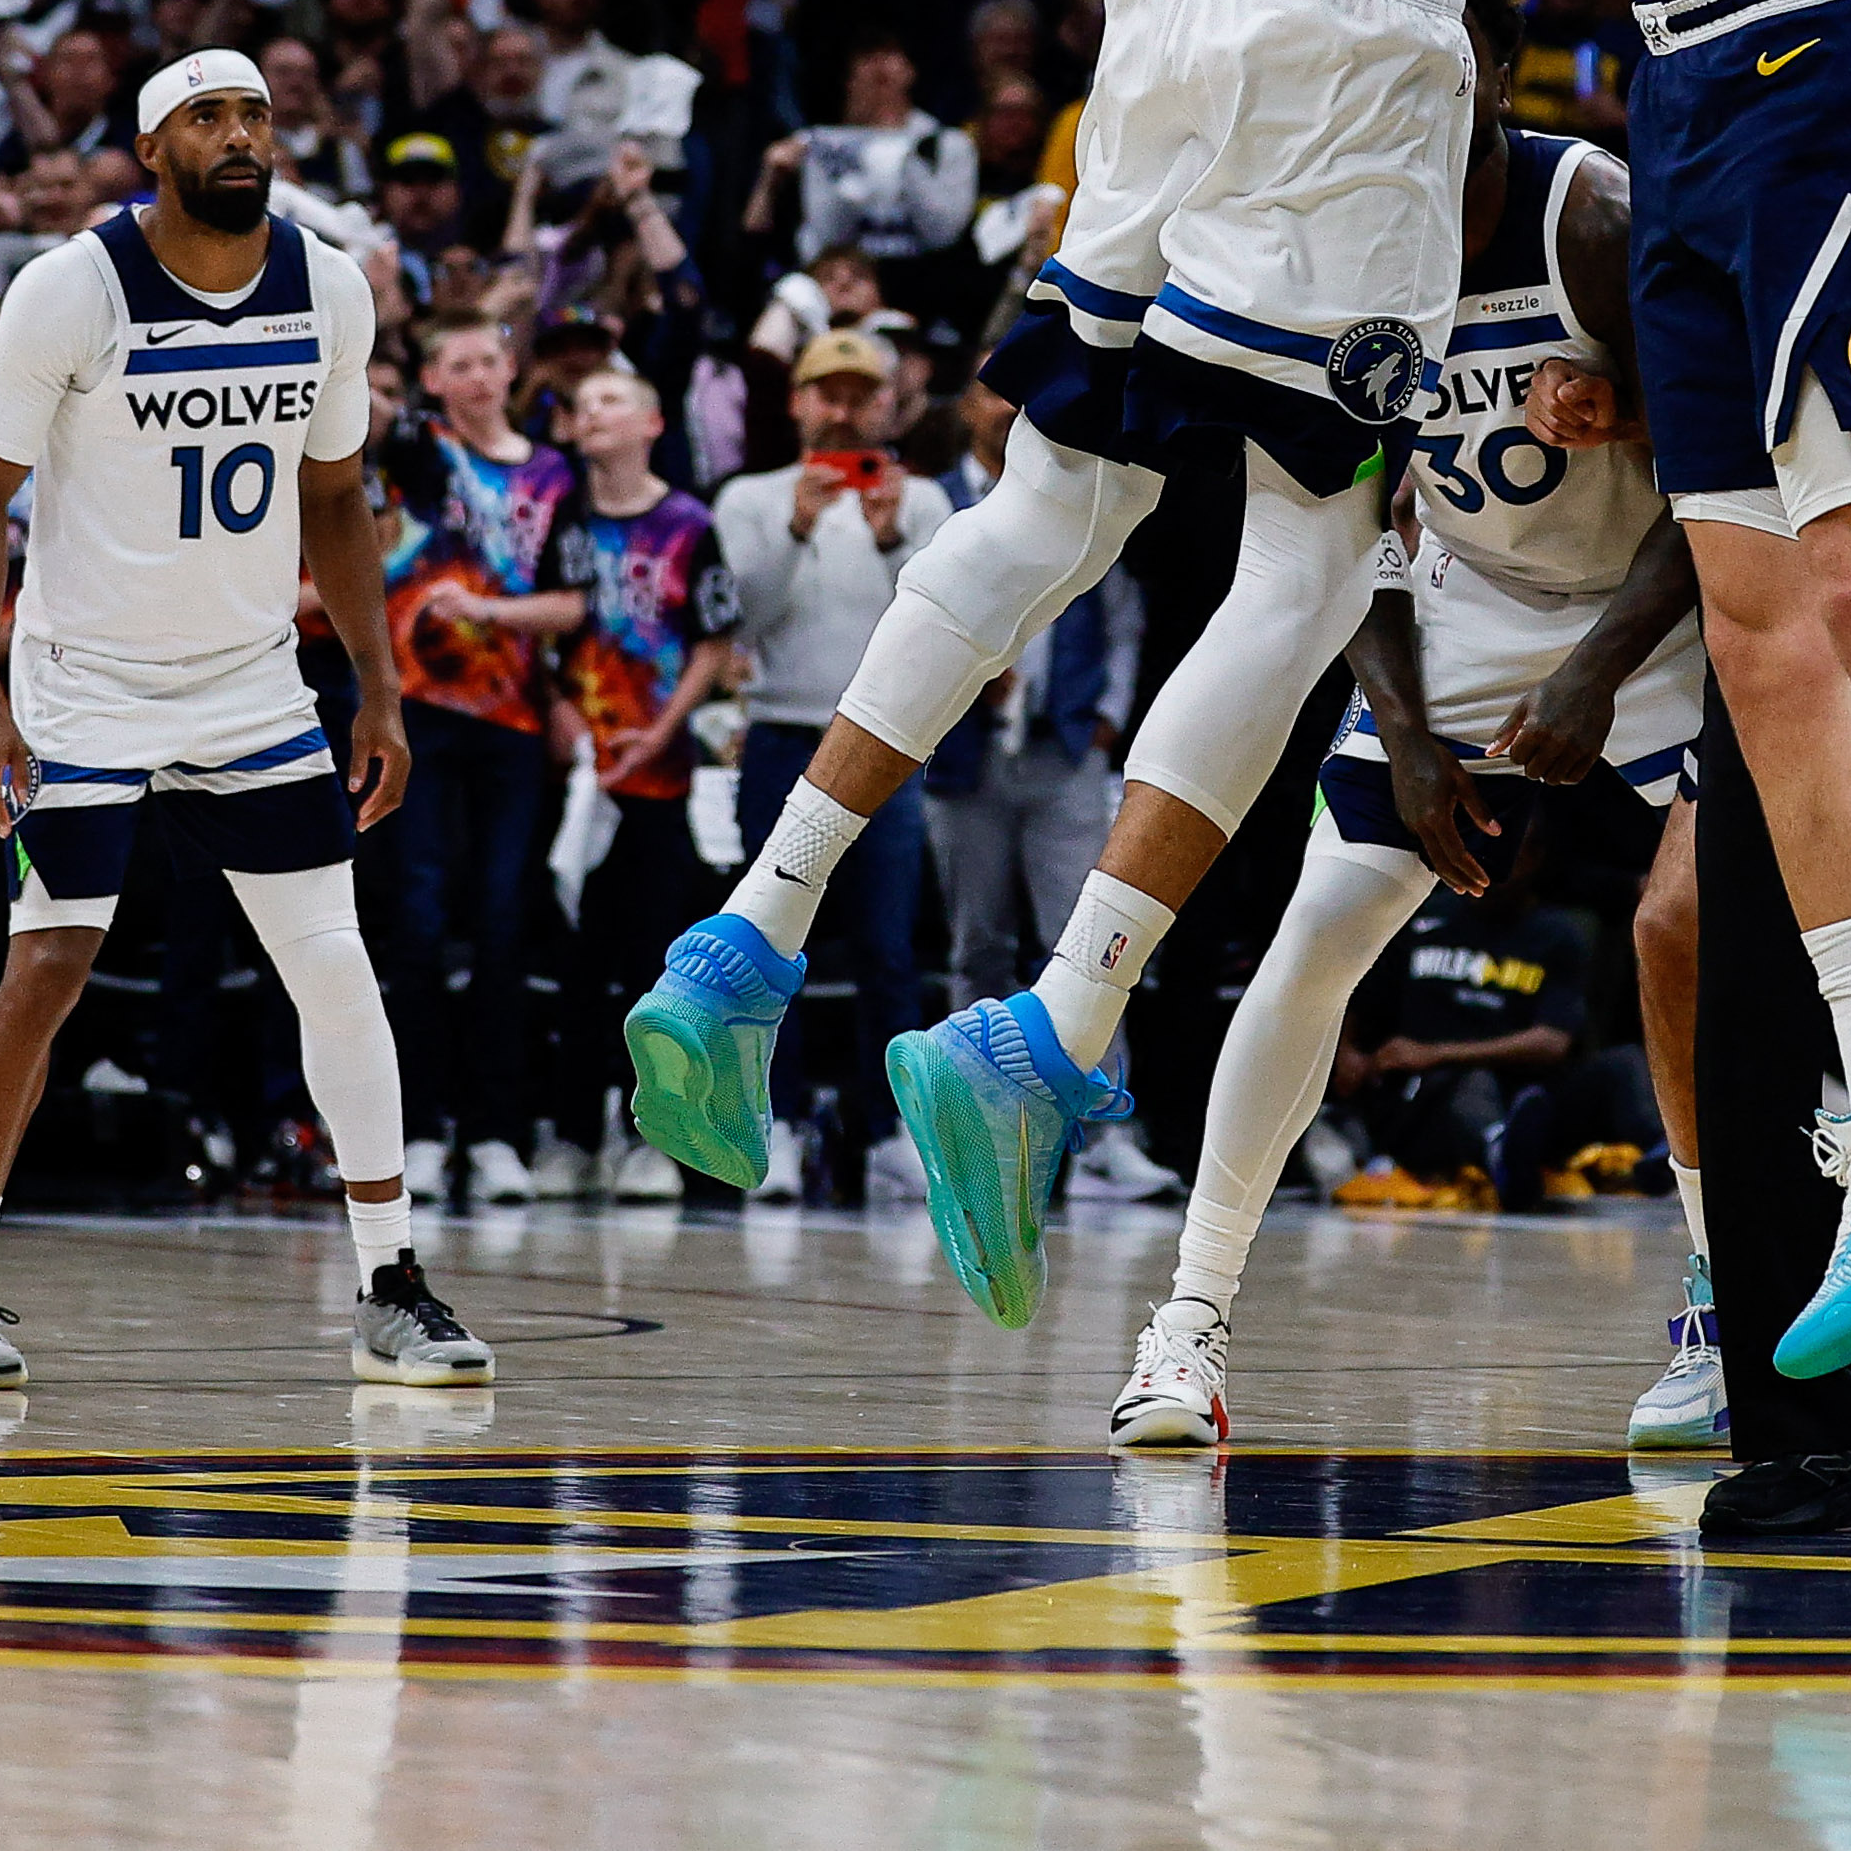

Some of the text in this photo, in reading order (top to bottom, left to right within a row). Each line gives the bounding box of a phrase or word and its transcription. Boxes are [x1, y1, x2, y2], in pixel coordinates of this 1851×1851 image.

[271, 319, 312, 334] sezzle
[1491, 295, 1541, 313] sezzle
[1331, 322, 1422, 412] MINNESOTA TIMBERWOLVES
[1425, 361, 1536, 421] OLVE
[125, 380, 318, 432] WOLVES
[171, 442, 276, 540] 10
[1413, 425, 1568, 514] 30
